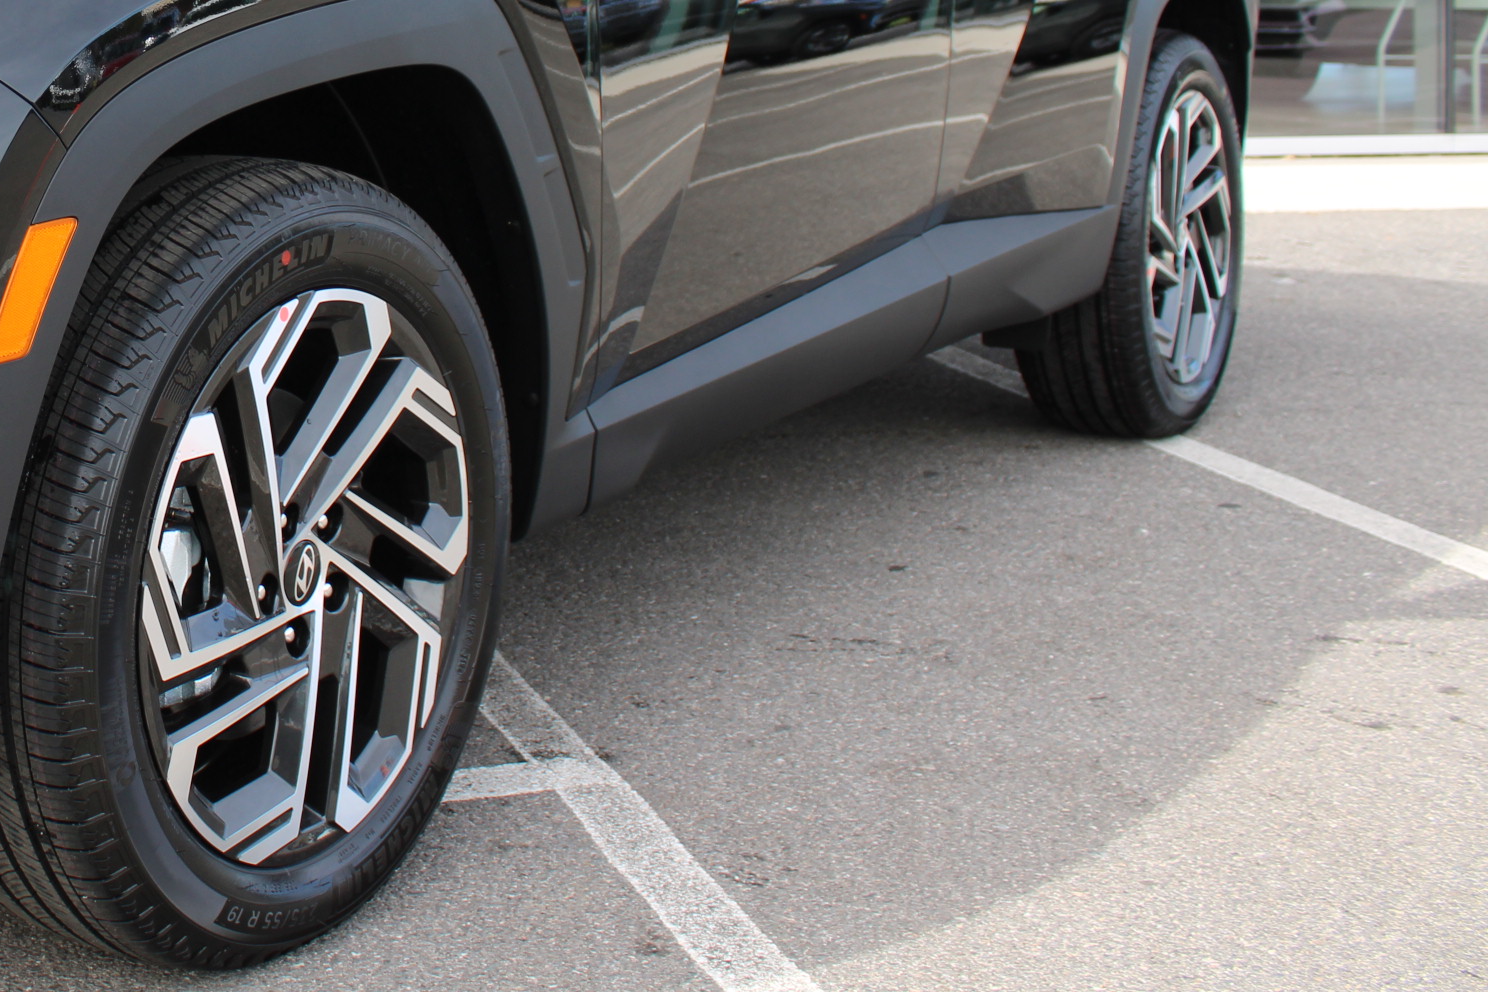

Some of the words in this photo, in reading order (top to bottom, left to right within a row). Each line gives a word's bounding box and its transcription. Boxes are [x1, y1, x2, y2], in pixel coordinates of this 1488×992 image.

[208, 234, 329, 348] MICHELIN
[227, 906, 244, 924] 19
[247, 910, 261, 928] R
